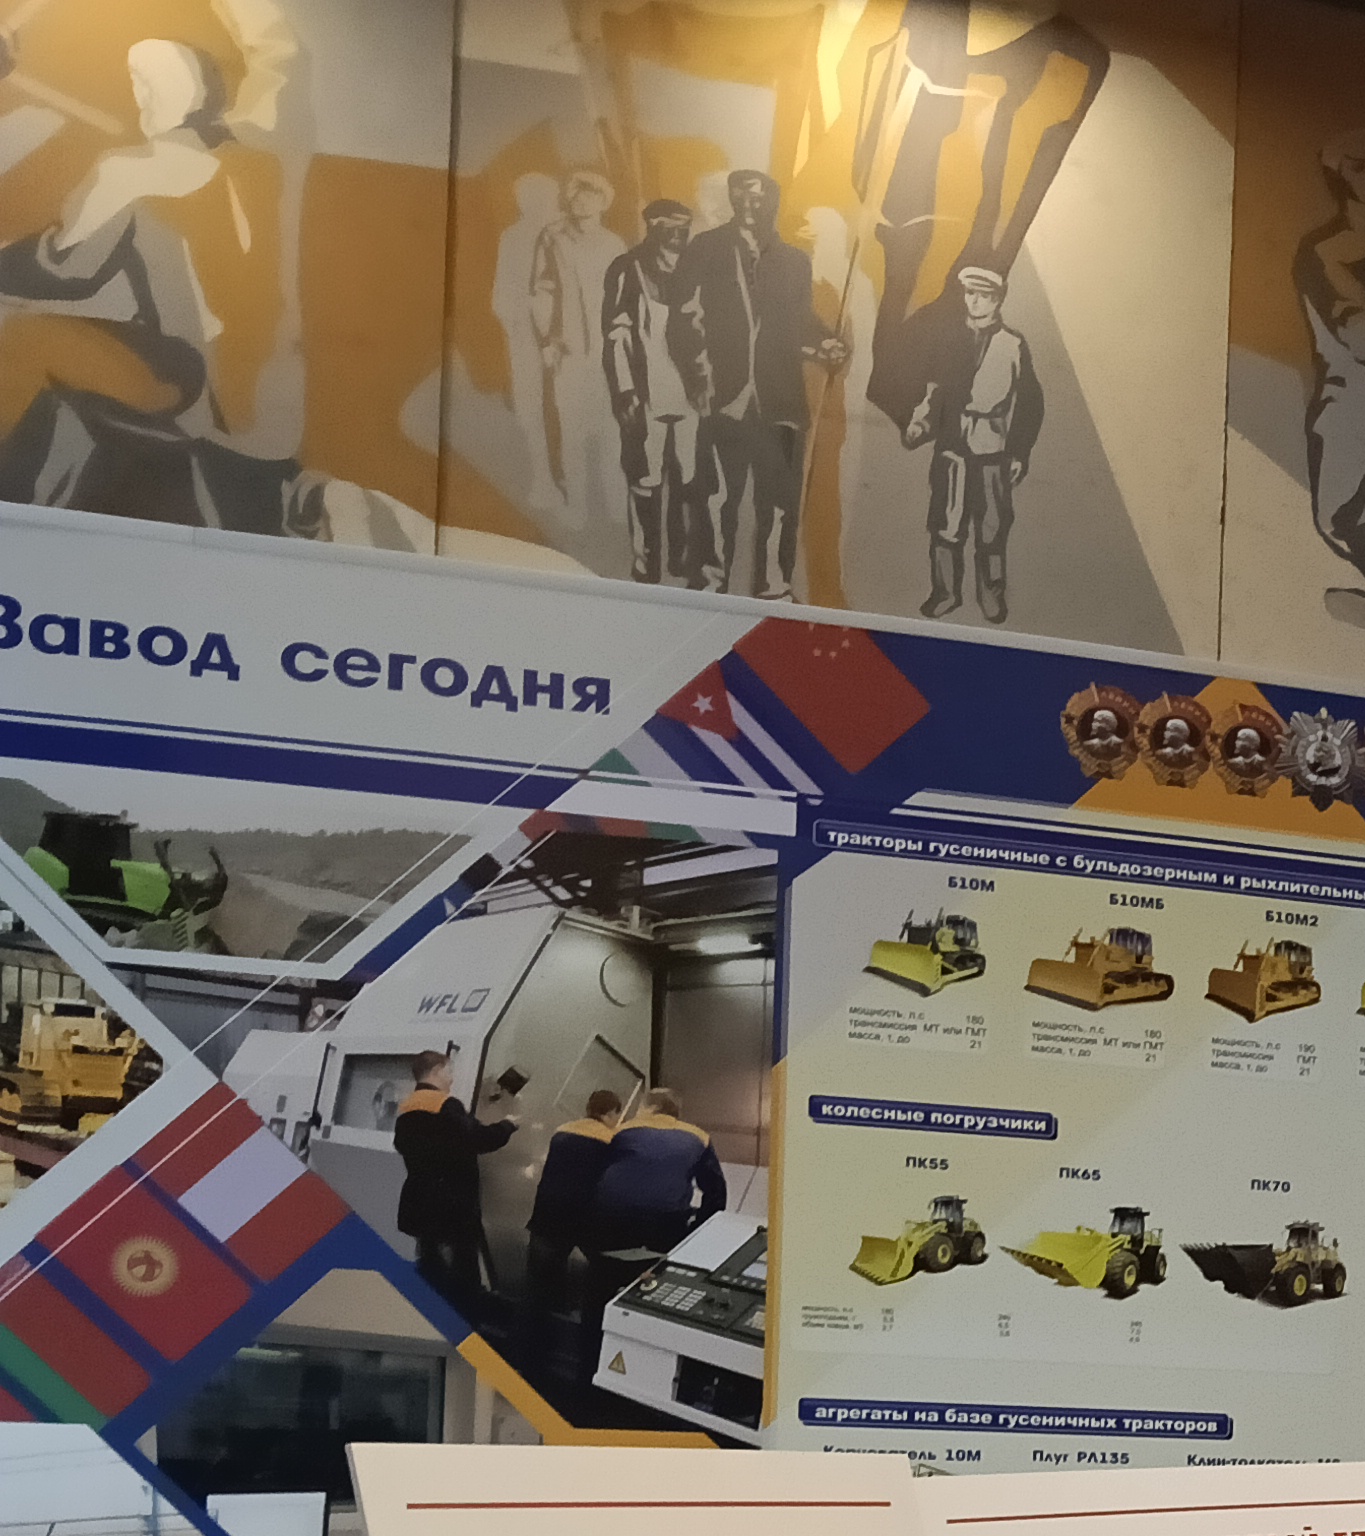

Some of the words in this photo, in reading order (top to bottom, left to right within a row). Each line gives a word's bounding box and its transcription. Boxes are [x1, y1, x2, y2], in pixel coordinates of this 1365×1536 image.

[280, 641, 610, 715] сегодня
[827, 831, 922, 852] тракторы
[928, 841, 1050, 866] гусеничные
[1055, 855, 1066, 866] с
[1073, 854, 1217, 883] бульдозерным
[1222, 874, 1234, 885] и
[947, 875, 994, 892] Б10М
[1109, 893, 1164, 909] Б10МБ
[1265, 909, 1318, 927] Б10М2
[417, 993, 461, 1014] WFL
[821, 1104, 924, 1122] колесные
[930, 1112, 1046, 1131] погрузчики
[905, 1155, 948, 1170] ПК55
[1058, 1166, 1101, 1180] ПК65
[1250, 1178, 1290, 1192] ПК70
[814, 1407, 907, 1423] агрегаты
[914, 1410, 938, 1421] на
[944, 1408, 992, 1423] базе
[998, 1413, 1116, 1429] гусеничных
[1122, 1418, 1217, 1435] тракторов
[945, 1448, 981, 1461] 10М
[1032, 1449, 1068, 1465] Плуг
